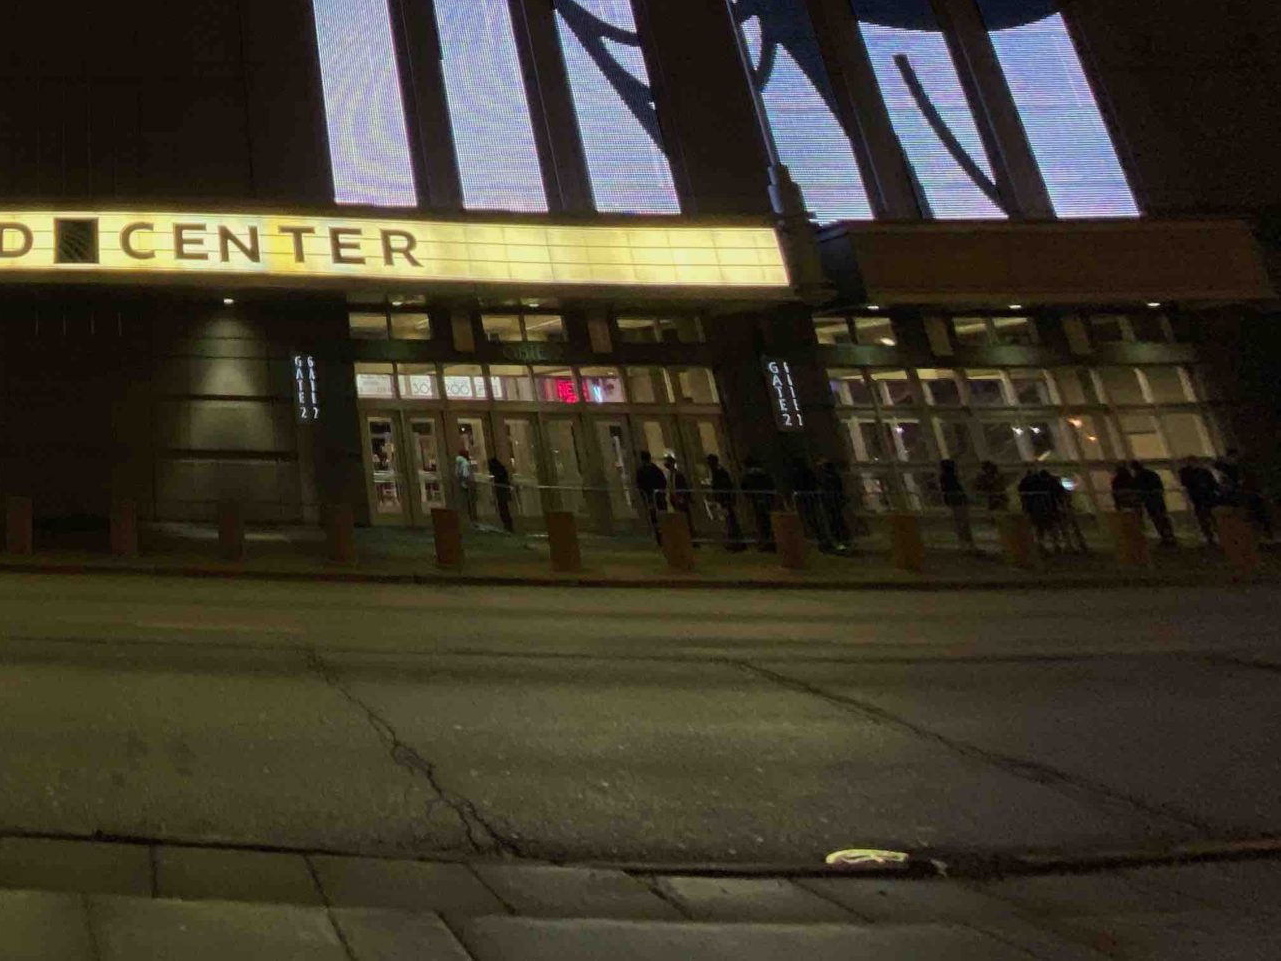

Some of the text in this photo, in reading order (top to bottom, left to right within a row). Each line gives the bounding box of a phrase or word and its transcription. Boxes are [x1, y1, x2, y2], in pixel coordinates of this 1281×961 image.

[119, 221, 424, 267] CENTER
[294, 355, 305, 405] GATE
[767, 361, 788, 412] GATE
[782, 413, 794, 426] 2
